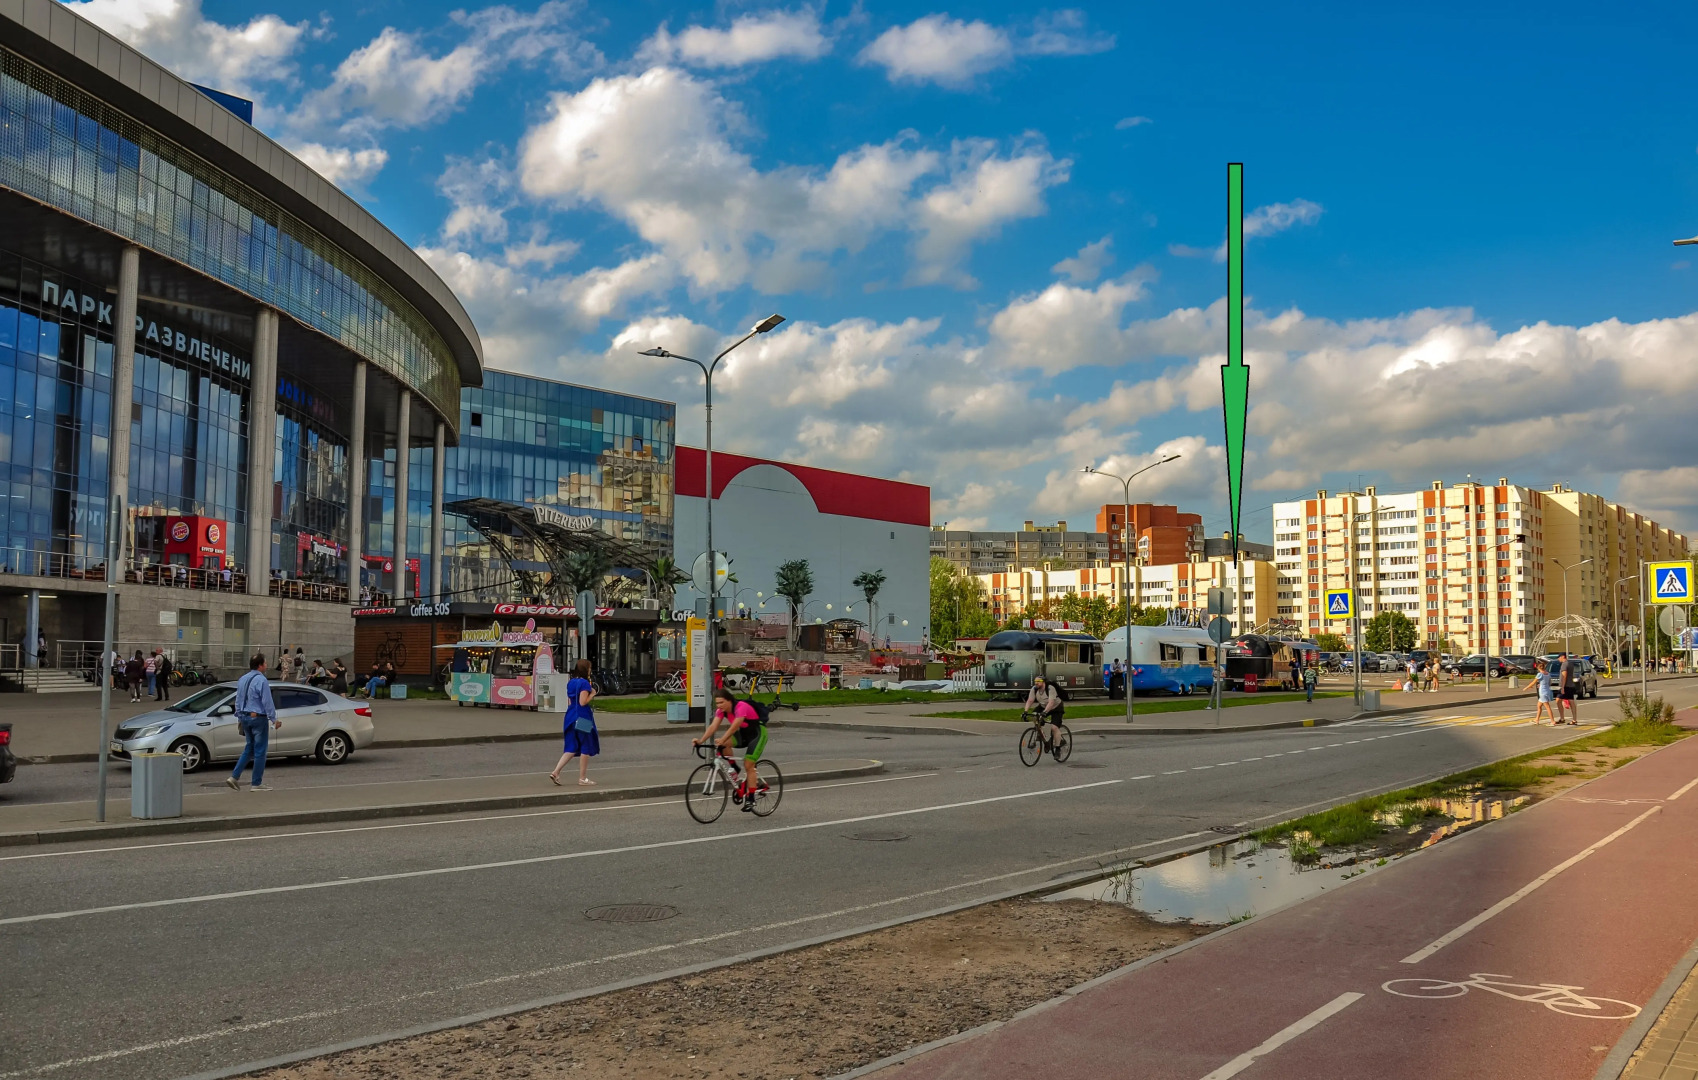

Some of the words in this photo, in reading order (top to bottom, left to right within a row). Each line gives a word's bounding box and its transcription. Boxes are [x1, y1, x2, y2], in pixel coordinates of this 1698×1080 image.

[43, 280, 113, 325] ПАРК
[532, 504, 593, 531] PITERLAND
[410, 604, 433, 616] Coffee
[434, 602, 450, 615] SOS
[503, 632, 543, 642] МОРОЖЕНОЕ
